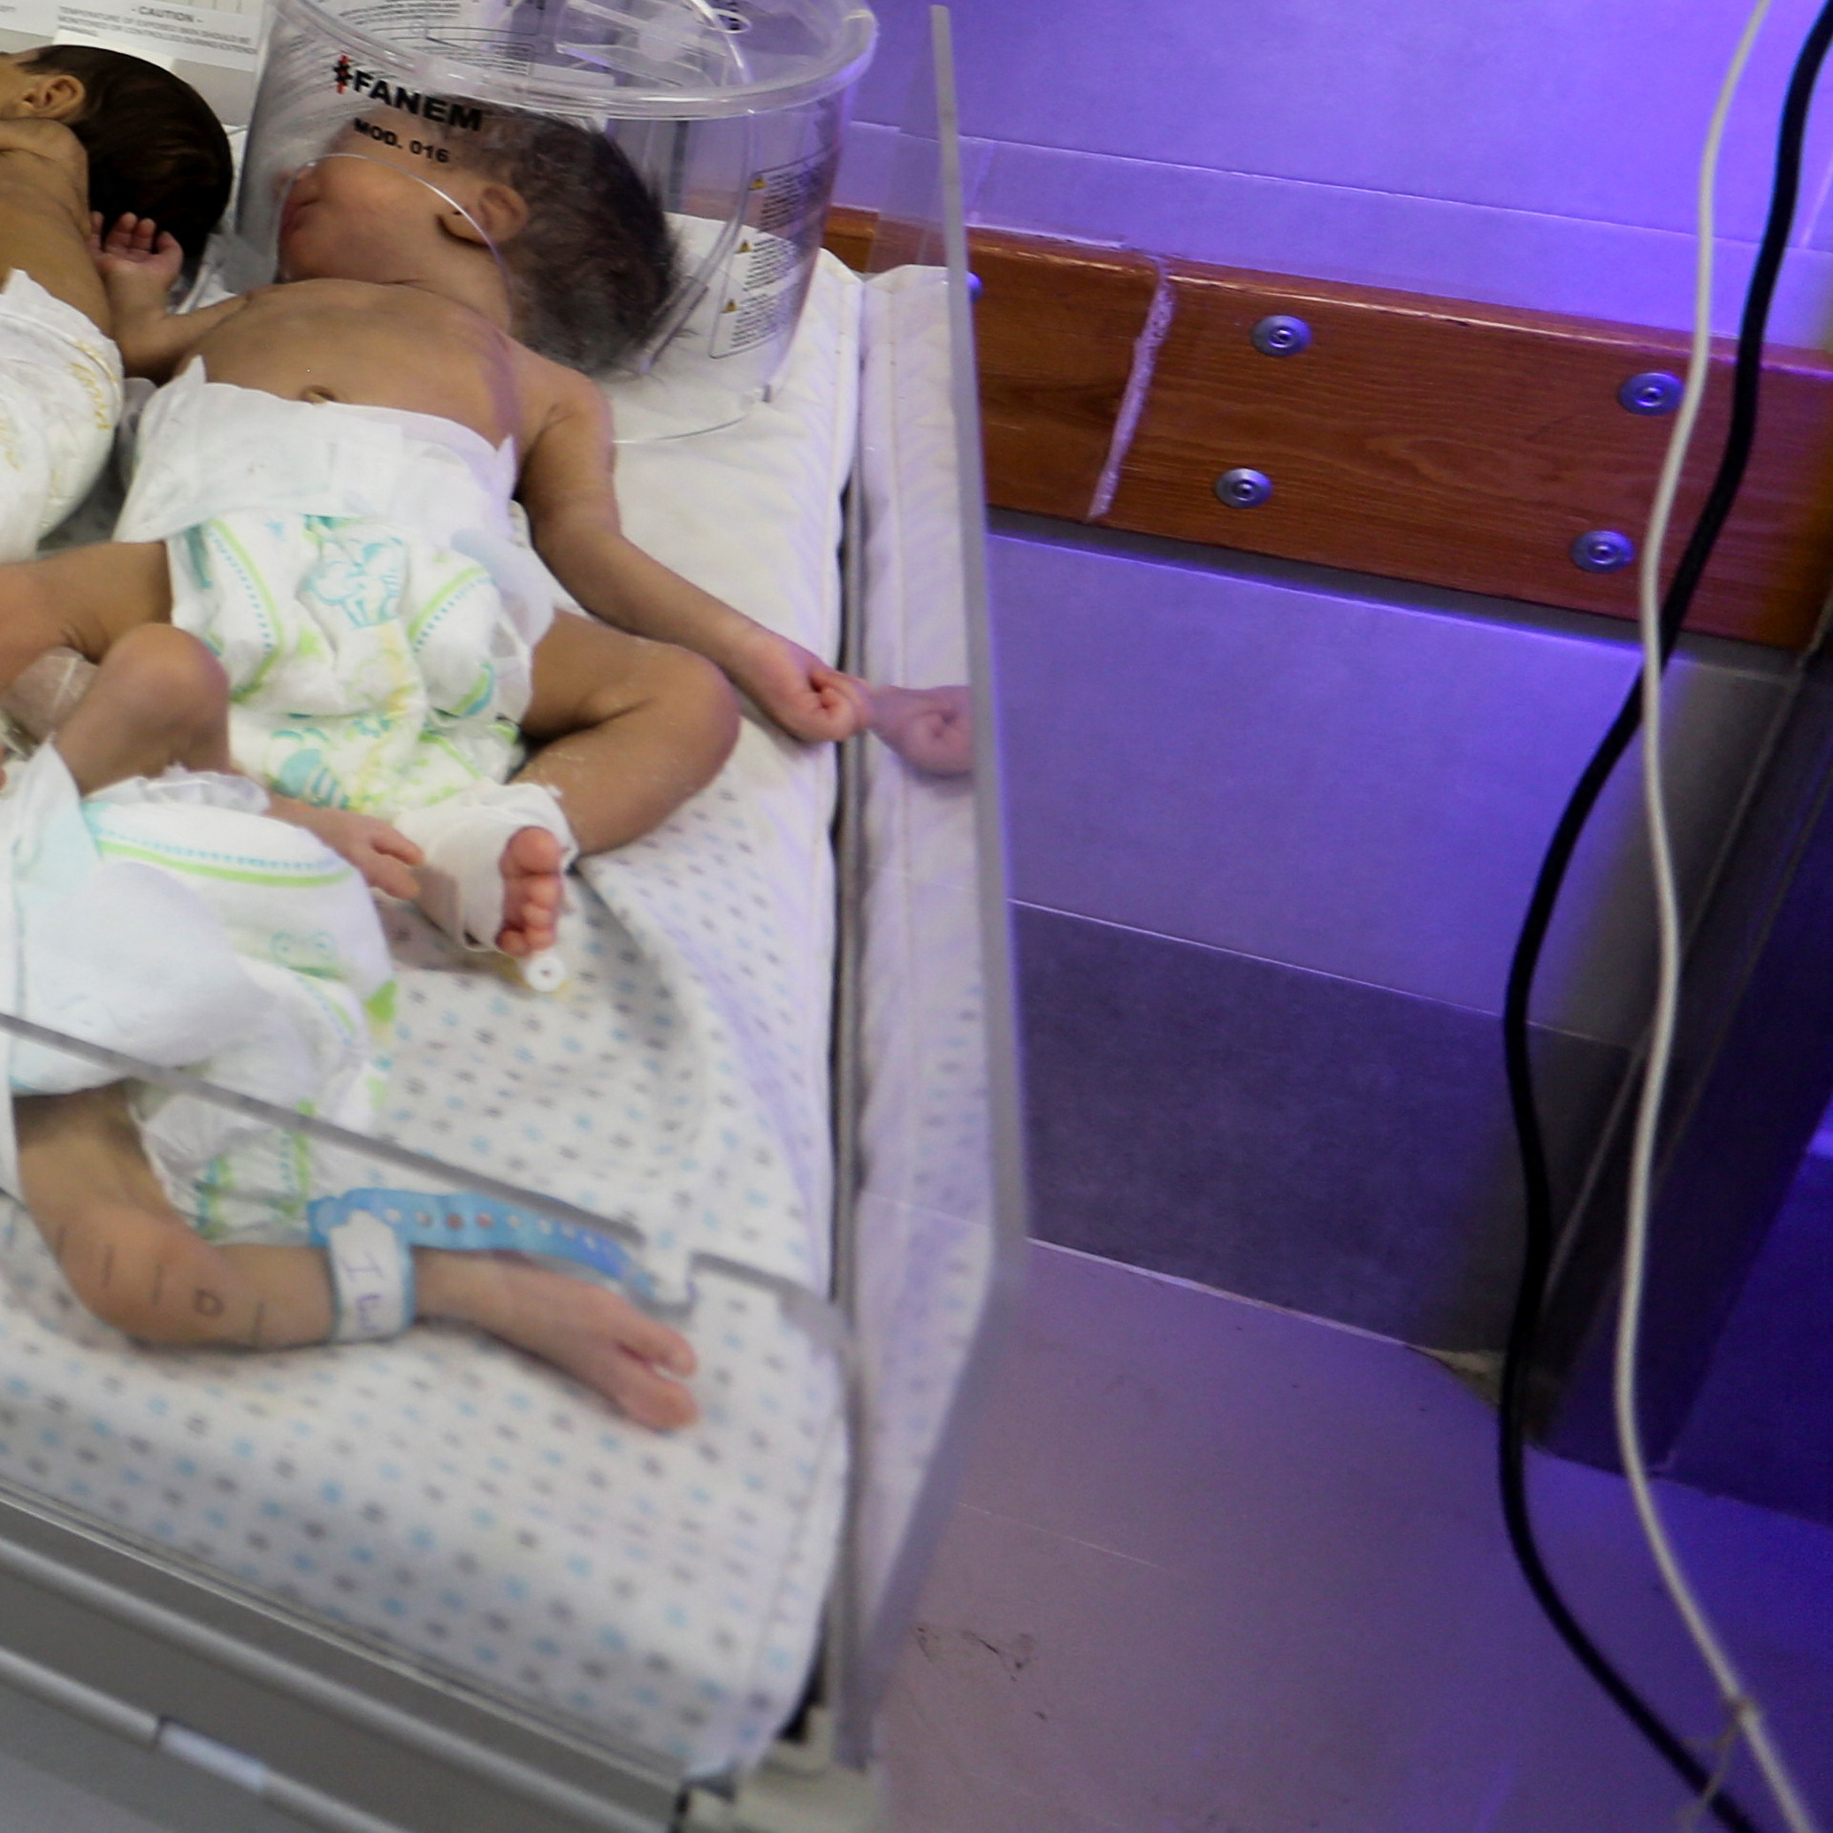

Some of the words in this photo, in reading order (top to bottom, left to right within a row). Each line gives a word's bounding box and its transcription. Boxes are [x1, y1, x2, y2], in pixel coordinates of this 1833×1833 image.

[138, 6, 195, 23] CAUTION
[354, 70, 483, 132] FANEM
[354, 118, 402, 149] MOD.
[410, 140, 450, 163] 016
